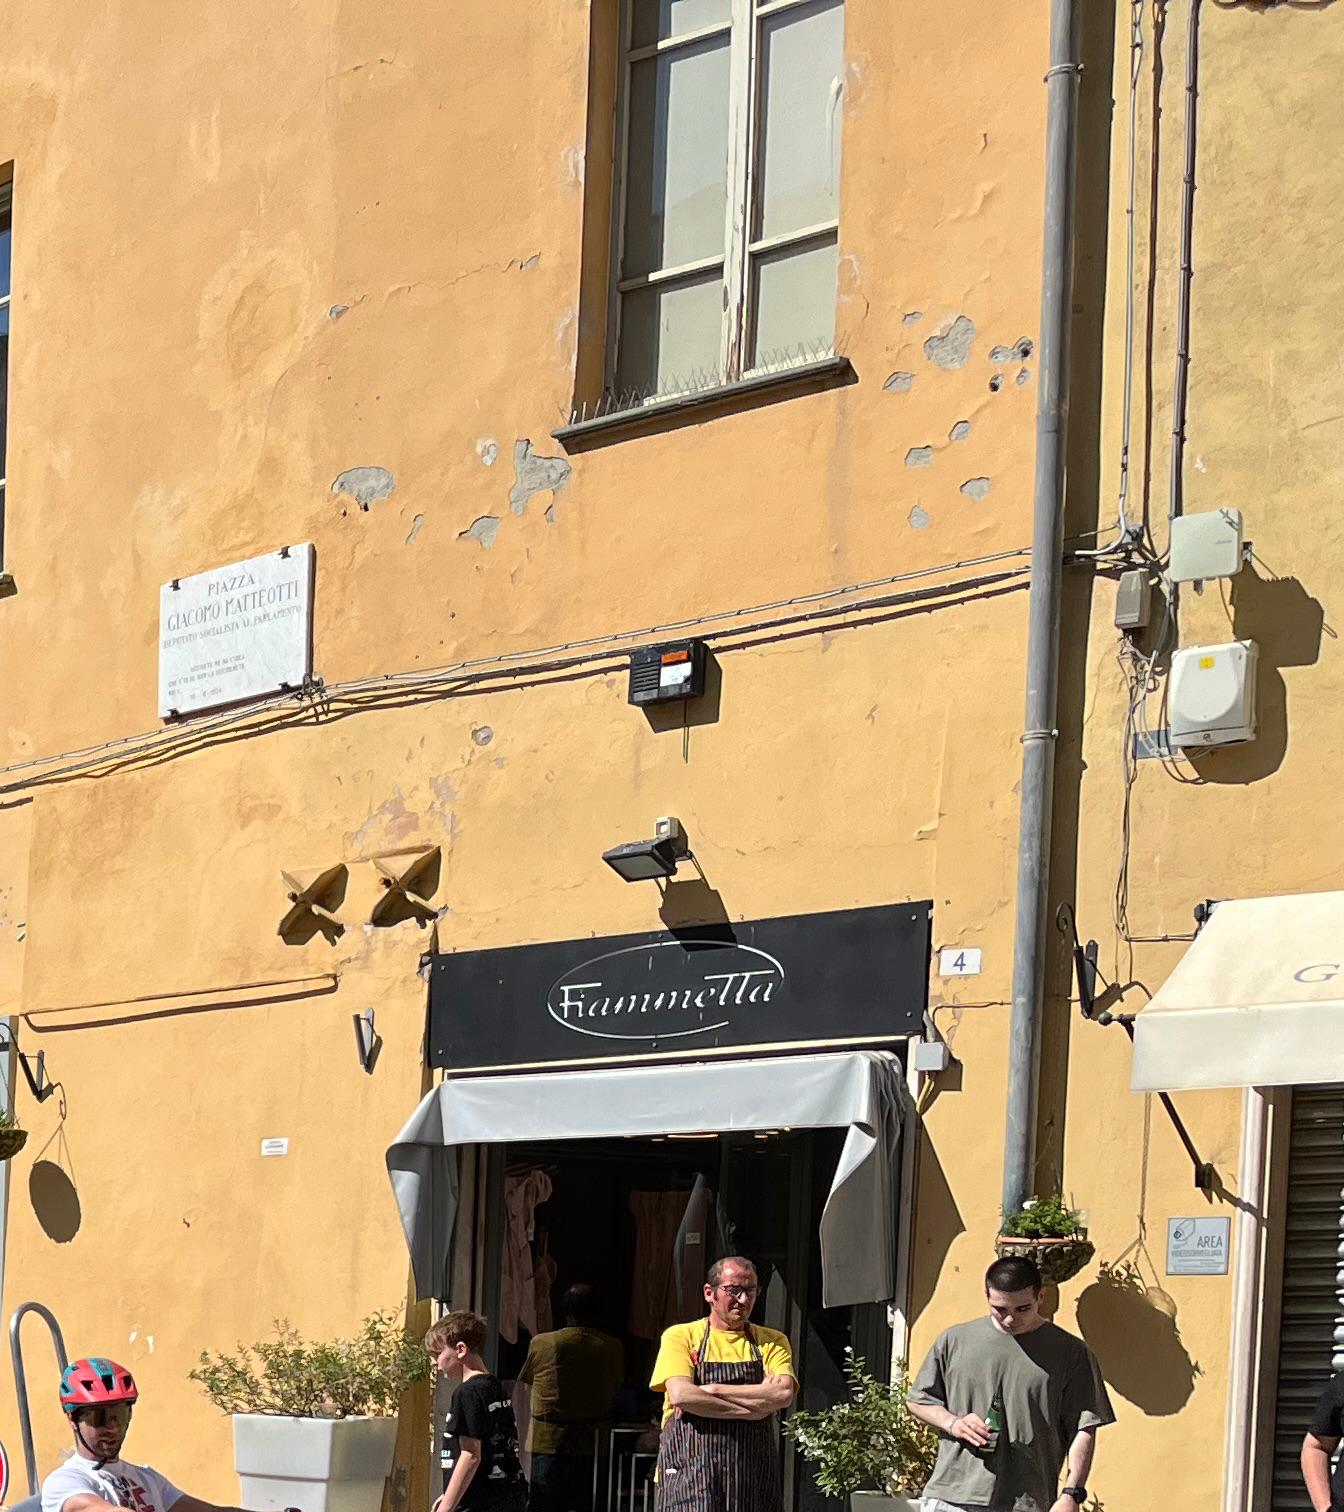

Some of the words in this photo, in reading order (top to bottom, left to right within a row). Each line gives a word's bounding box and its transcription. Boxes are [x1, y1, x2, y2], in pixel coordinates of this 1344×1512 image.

[208, 574, 256, 596] PIAZZA
[168, 602, 221, 631] GIACOMO
[225, 580, 299, 616] MATTEOTTI
[199, 623, 240, 640] SOCIALISTA
[953, 952, 966, 971] 4
[560, 970, 775, 1018] Fiammetta
[1197, 1236, 1223, 1248] AREA
